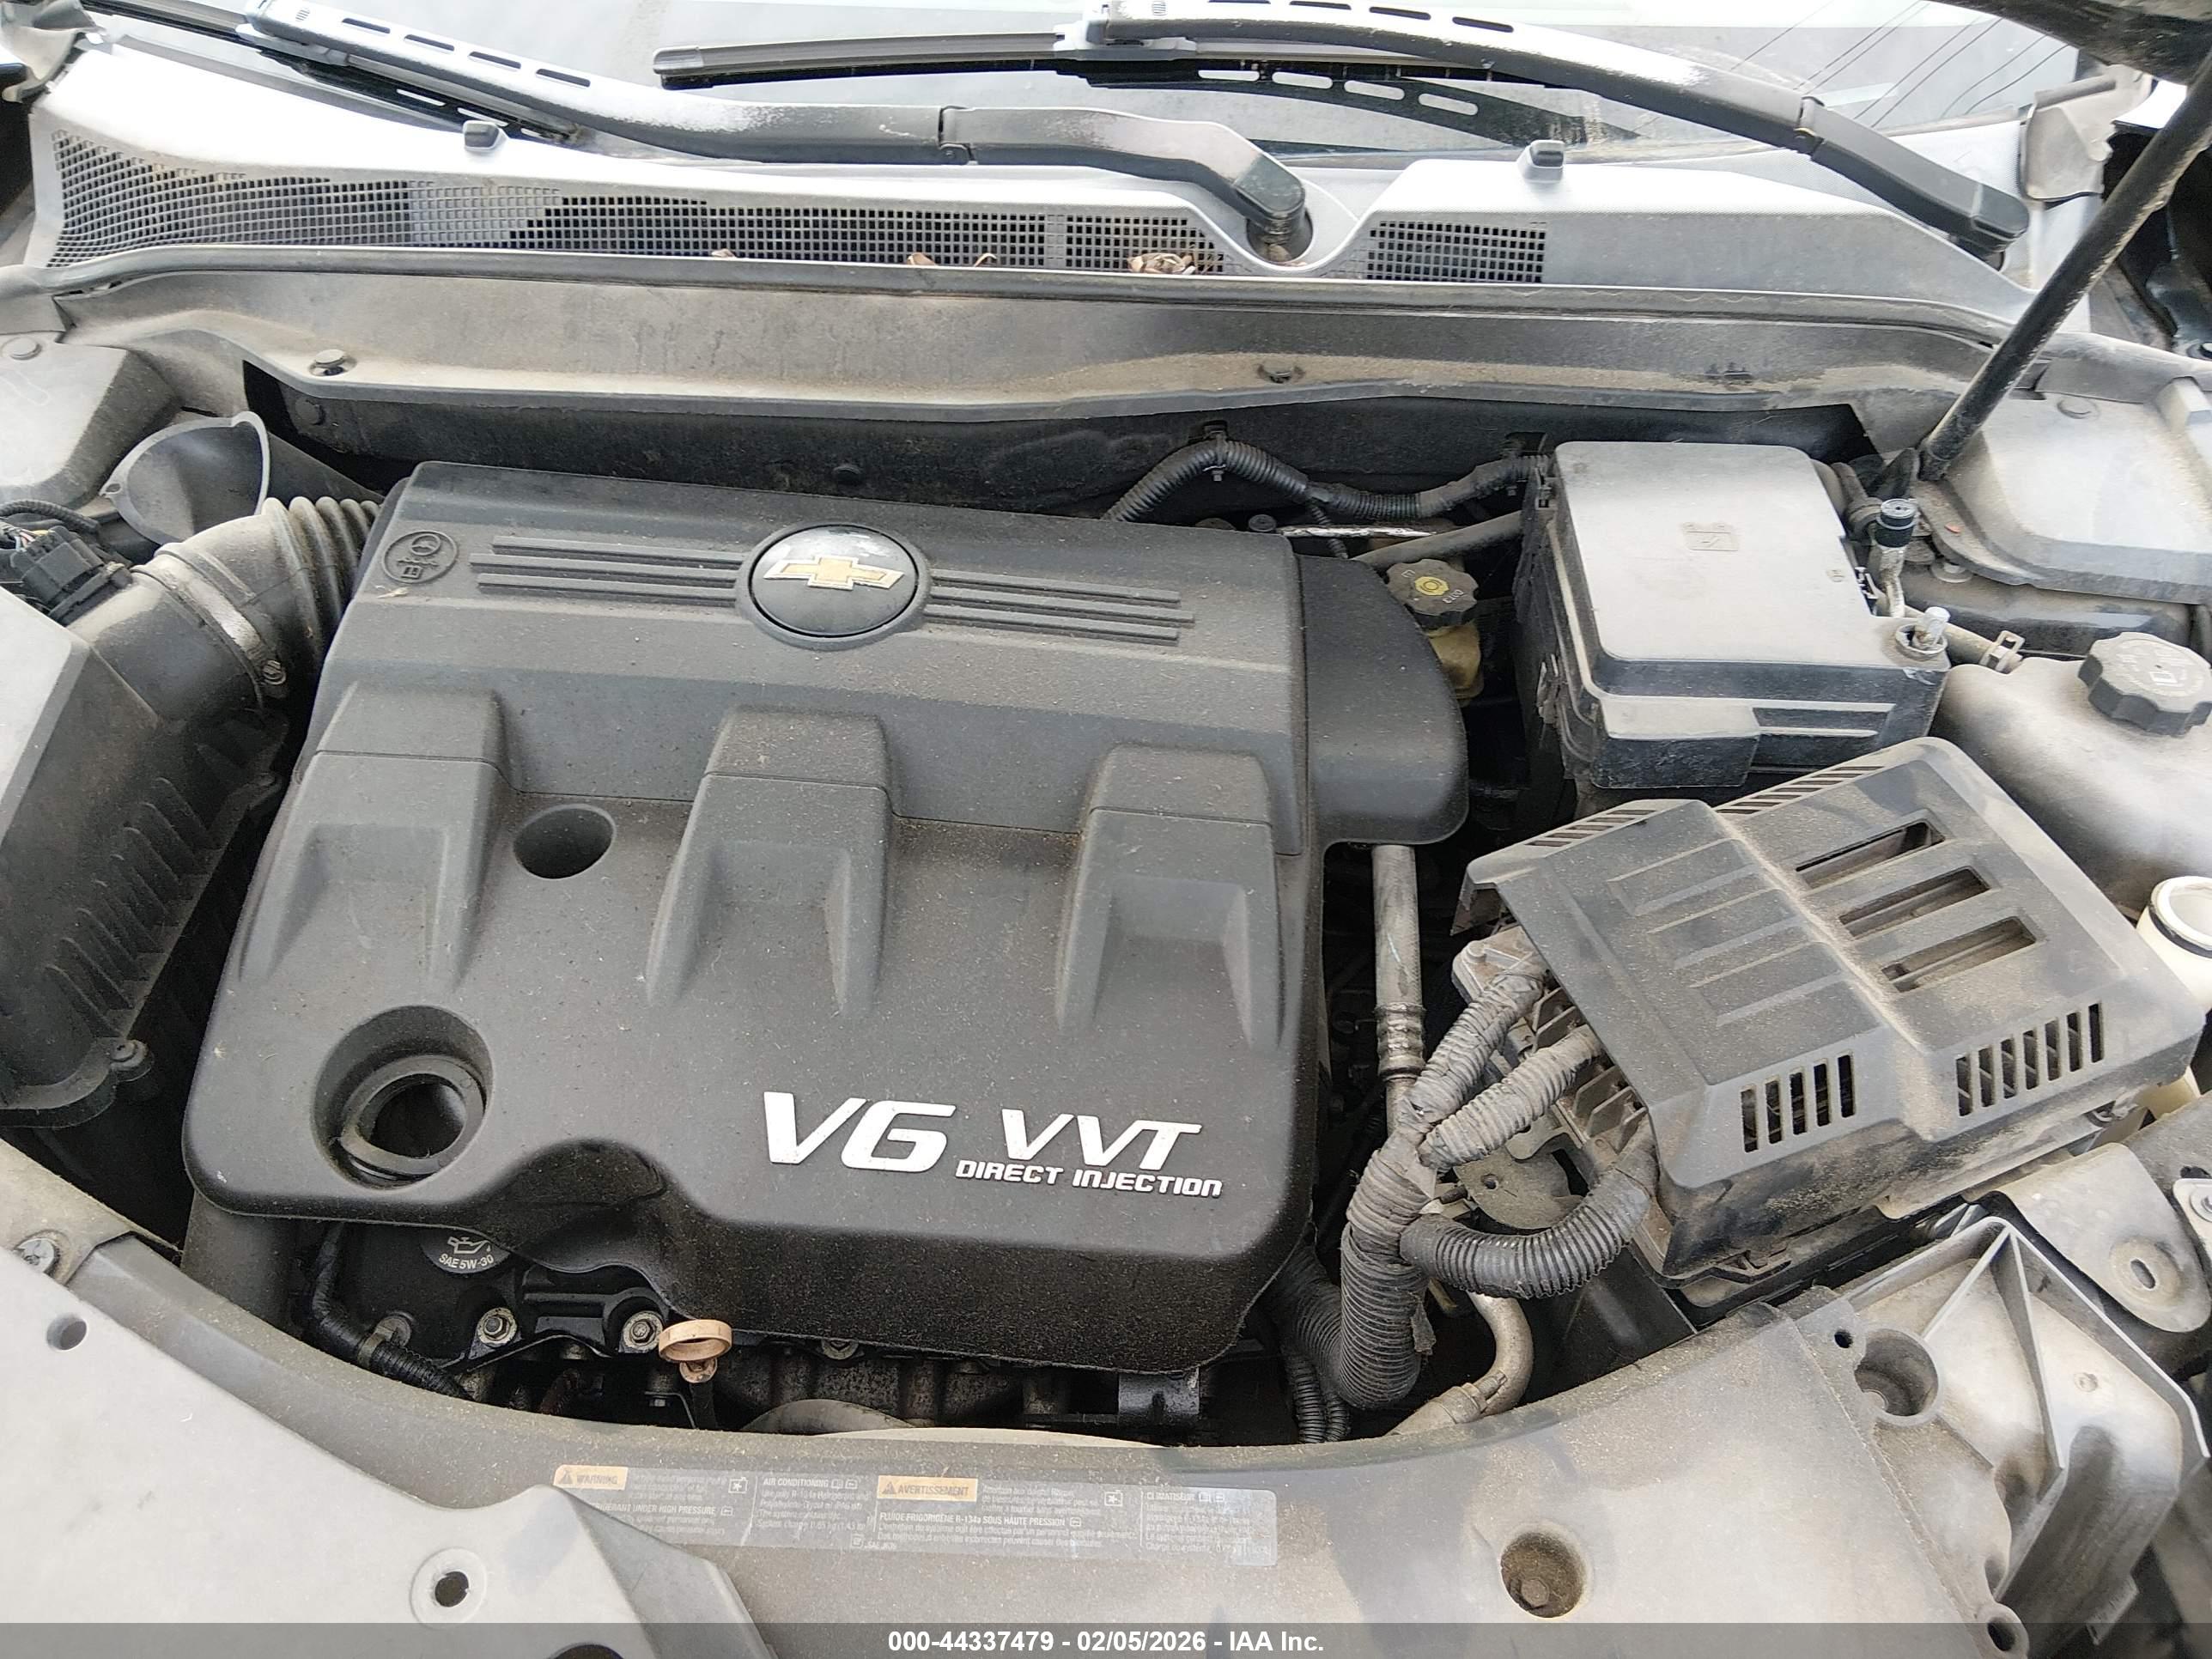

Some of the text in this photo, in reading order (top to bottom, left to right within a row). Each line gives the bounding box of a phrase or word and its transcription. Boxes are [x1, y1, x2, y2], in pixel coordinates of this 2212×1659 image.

[763, 1091, 1203, 1172] V6 VVT
[955, 1159, 1224, 1199] DIRECT INJECTION
[439, 1253, 494, 1269] SAE 5W-30
[576, 1474, 618, 1485] WARNING
[763, 1478, 830, 1488] AIR CONDITIONING
[896, 1485, 969, 1497] AVERTISSEMENT
[633, 1504, 658, 1513] UNDER
[659, 1505, 677, 1514] HIGH
[678, 1505, 717, 1515] PRESSURE
[879, 1512, 904, 1522] FLUIDE
[955, 1515, 981, 1524] R-134a
[982, 1516, 1002, 1525] SOUS
[1004, 1516, 1028, 1526] HAUTE
[1029, 1516, 1066, 1527] PRESSION
